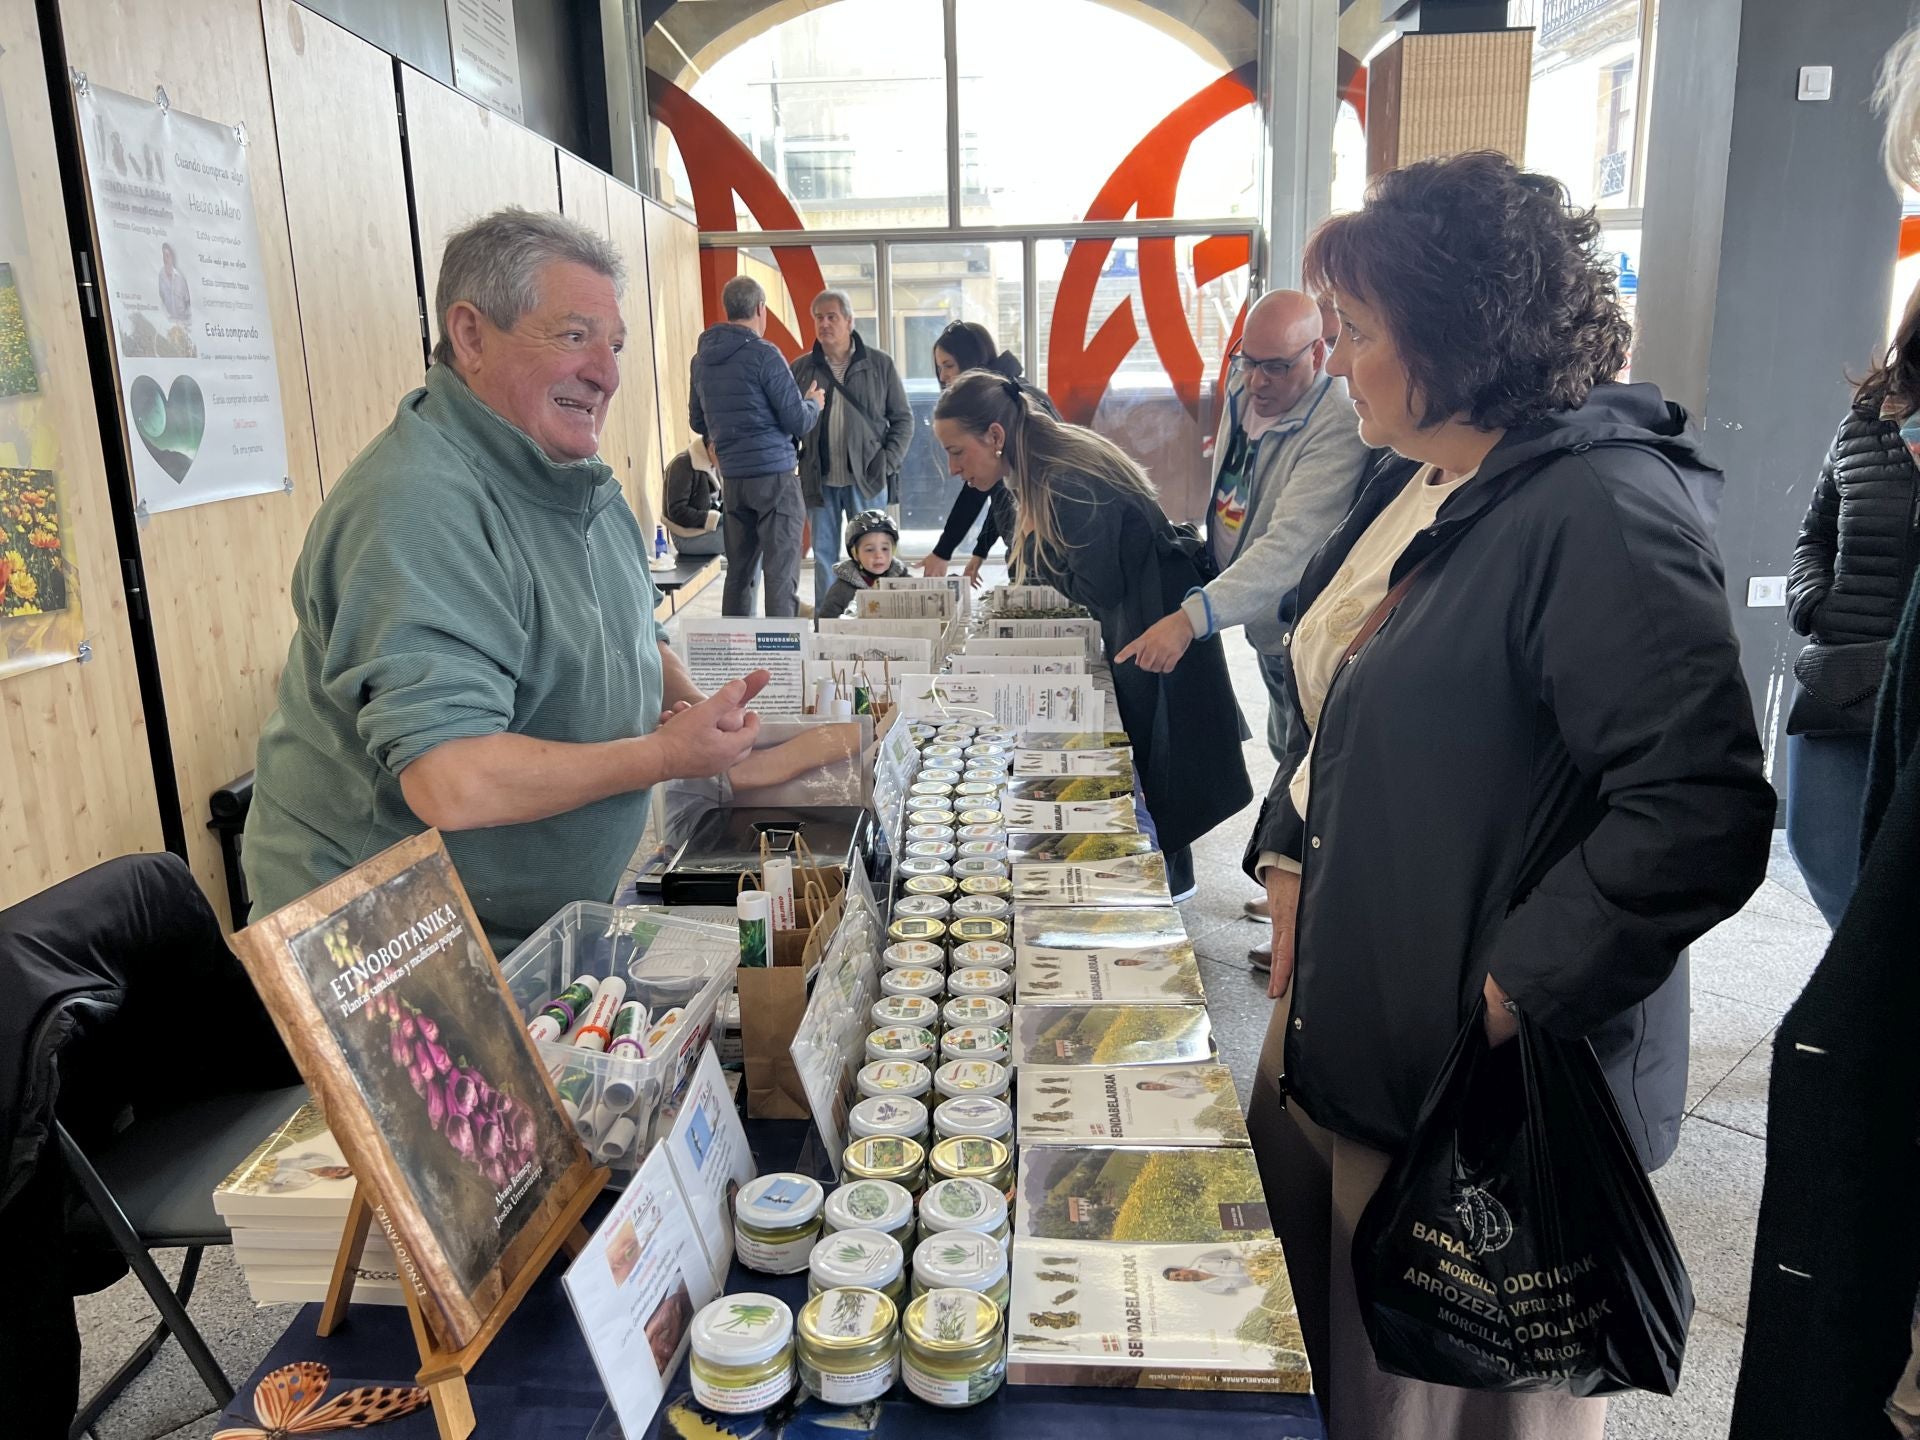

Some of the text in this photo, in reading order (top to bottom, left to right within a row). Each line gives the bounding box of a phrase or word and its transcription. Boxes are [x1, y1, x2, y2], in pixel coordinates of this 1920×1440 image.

[174, 153, 201, 173] Cuando
[188, 193, 213, 215] Hecho
[221, 200, 242, 222] Mano
[205, 323, 259, 341] Estás comprando
[329, 903, 457, 1001] ETNOBOTANIKA
[340, 923, 465, 1018] Plantas sanadoras y medicina popular
[1104, 1073, 1124, 1138] SENDABELARRAK
[510, 1161, 533, 1187] Bermejo
[494, 1204, 513, 1229] Joseba
[1122, 1253, 1145, 1358] SENDABELARRAK
[1437, 1306, 1513, 1351] MORCILLA
[1221, 1376, 1280, 1384] SENDABELARRAK
